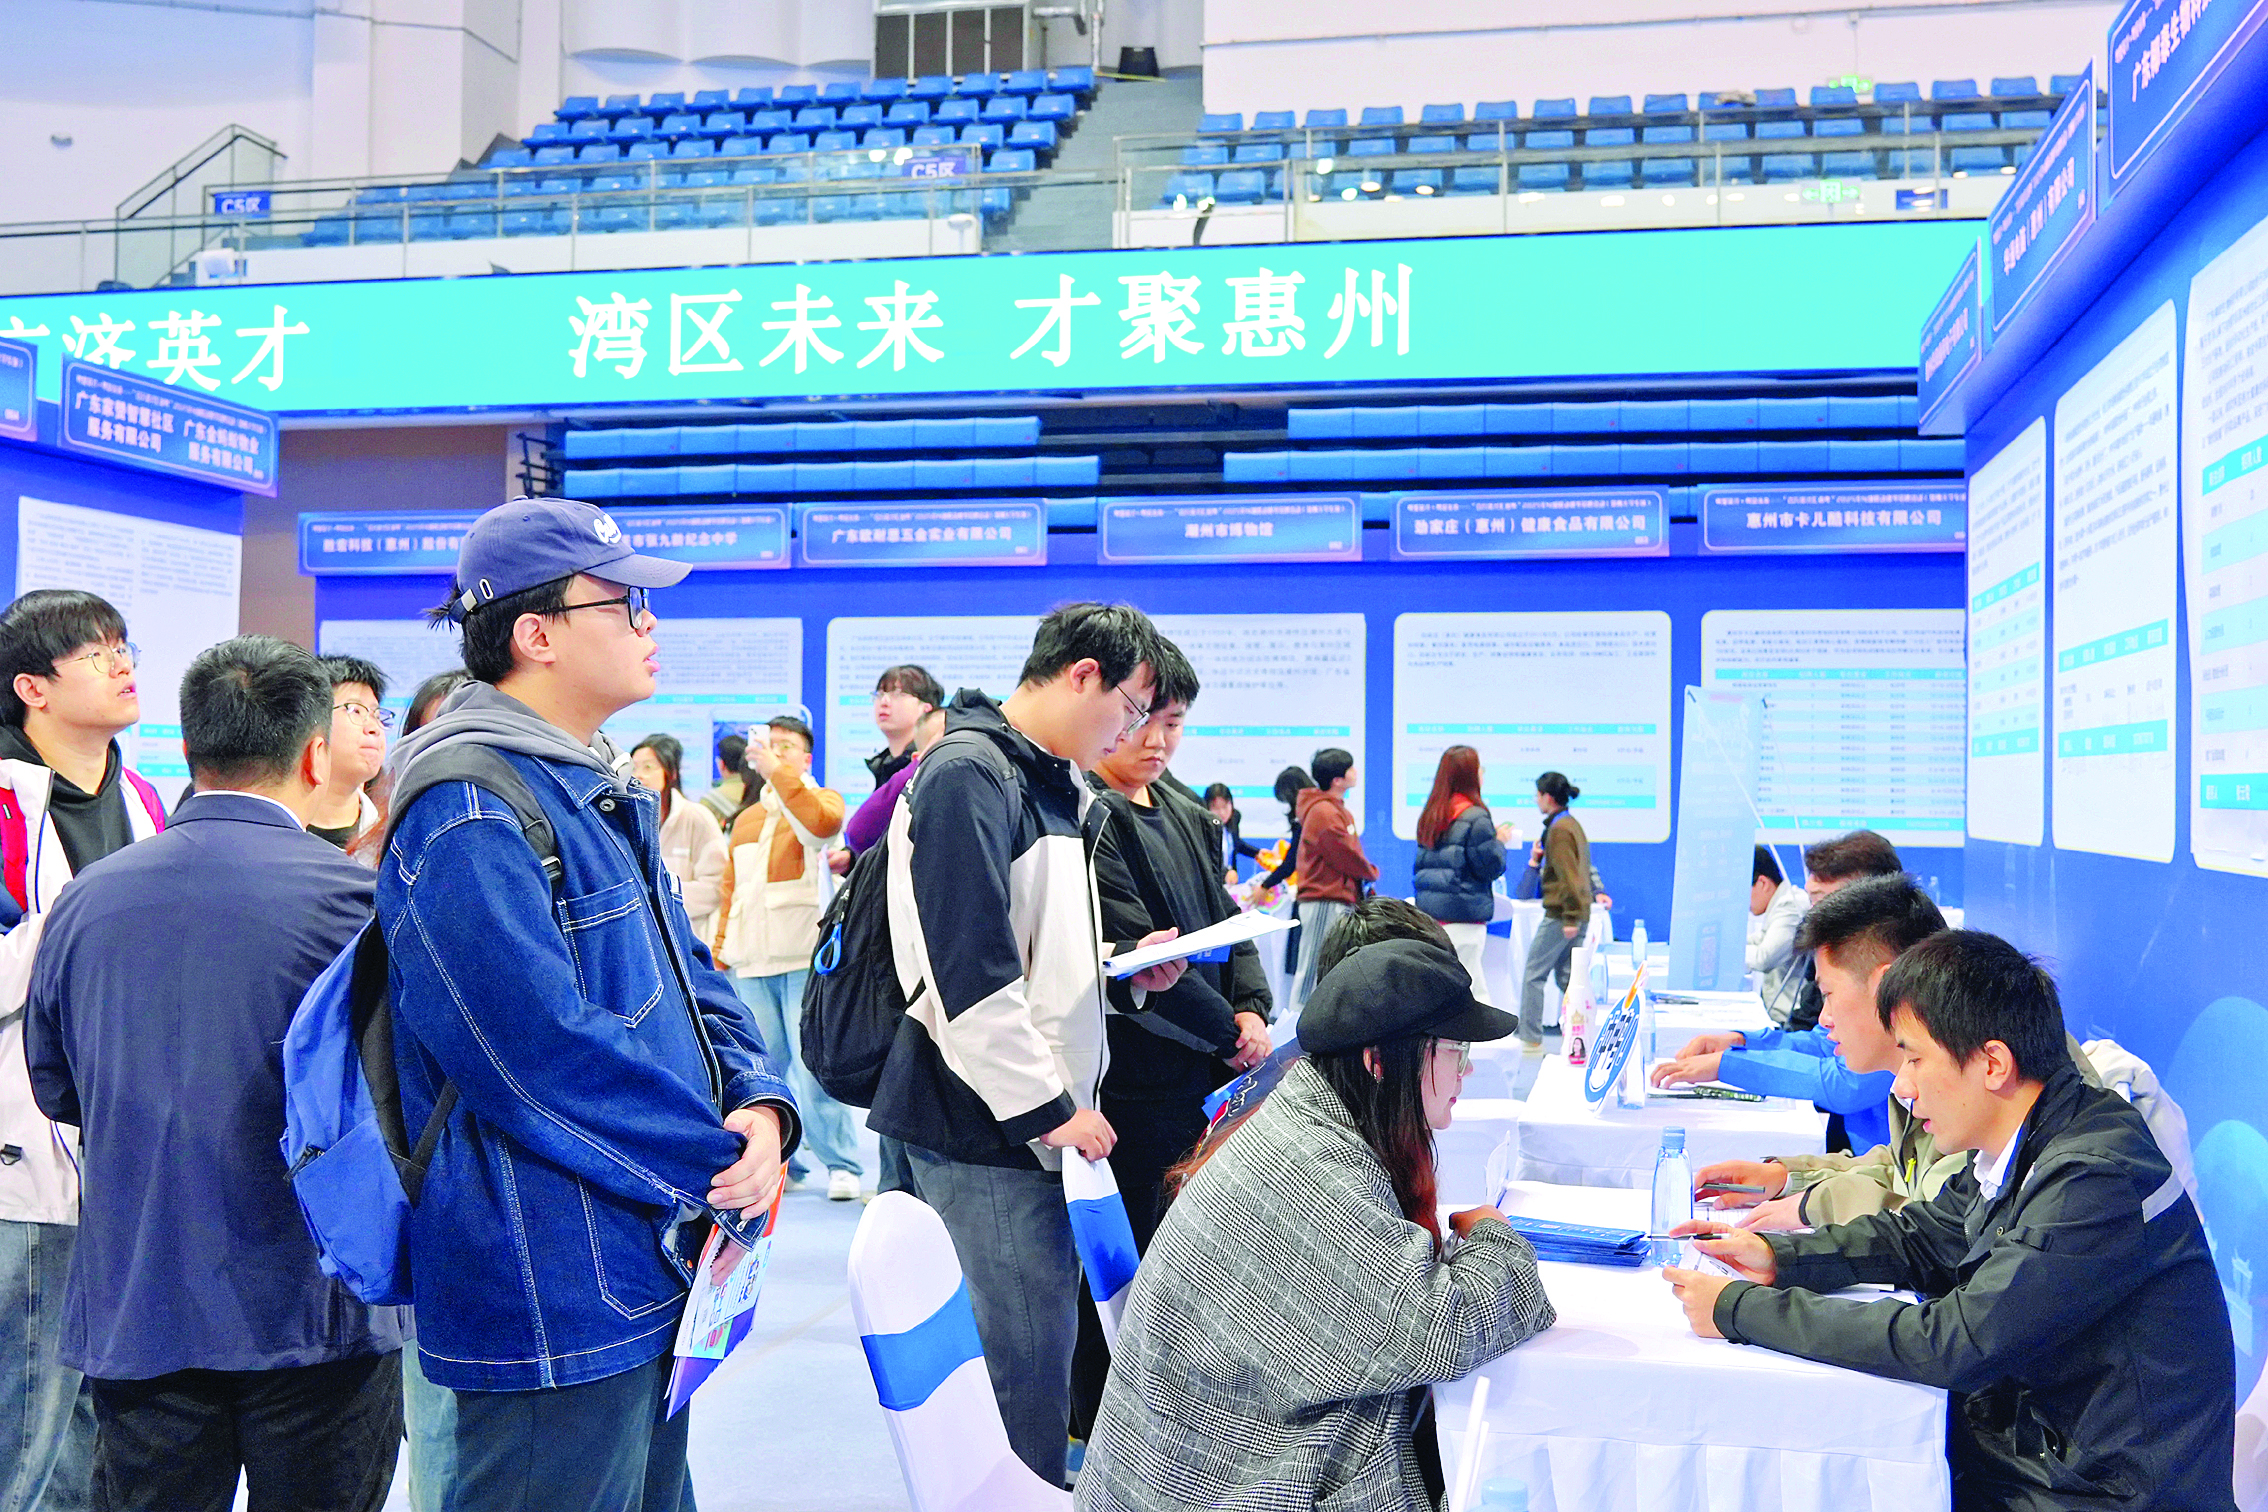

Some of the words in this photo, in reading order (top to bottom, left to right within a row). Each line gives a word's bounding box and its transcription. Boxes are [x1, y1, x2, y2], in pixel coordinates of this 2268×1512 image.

[911, 162, 956, 179] C5区
[221, 197, 261, 214] C5区
[567, 279, 945, 380] 湾区未来
[1009, 262, 1414, 368] 才聚惠州
[0, 305, 310, 391] 济英才
[87, 416, 161, 453] 服务有限公司
[1746, 510, 1942, 528] 惠州市卡儿酷科技有限公司
